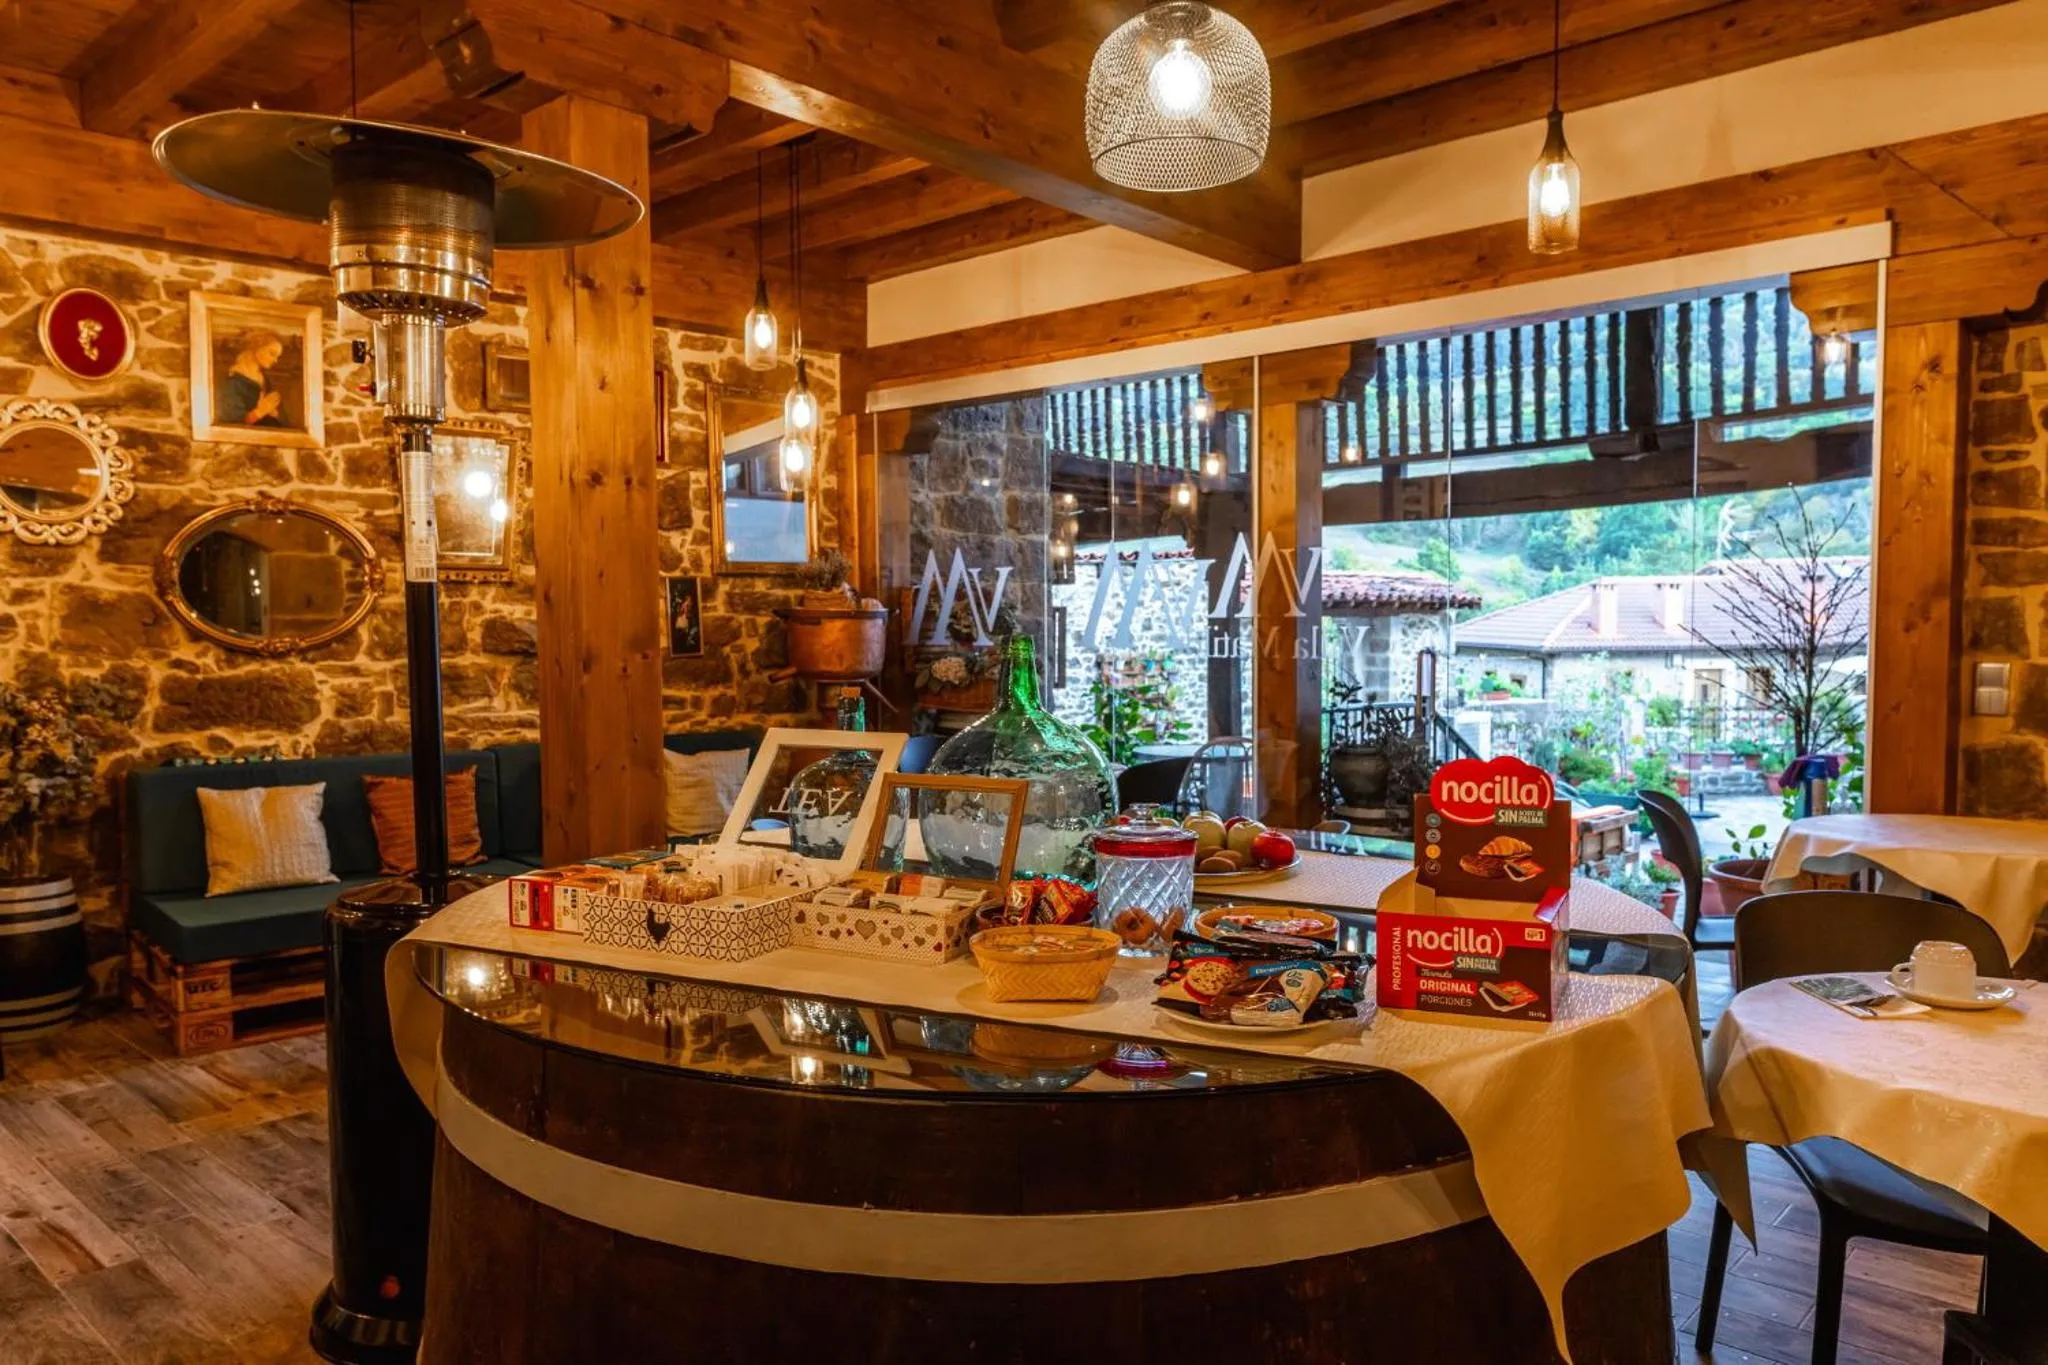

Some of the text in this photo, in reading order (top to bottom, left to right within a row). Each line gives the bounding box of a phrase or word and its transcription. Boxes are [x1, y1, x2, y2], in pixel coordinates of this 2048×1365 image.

[1441, 775, 1539, 806] nocilla
[1498, 809, 1517, 824] SIN
[1407, 926, 1492, 955] nocilla
[1391, 927, 1402, 991] PROFESIONAL
[1456, 956, 1474, 969] SIN
[1419, 980, 1474, 995] ORIGINAL
[1420, 994, 1473, 1007] PORCIONES
